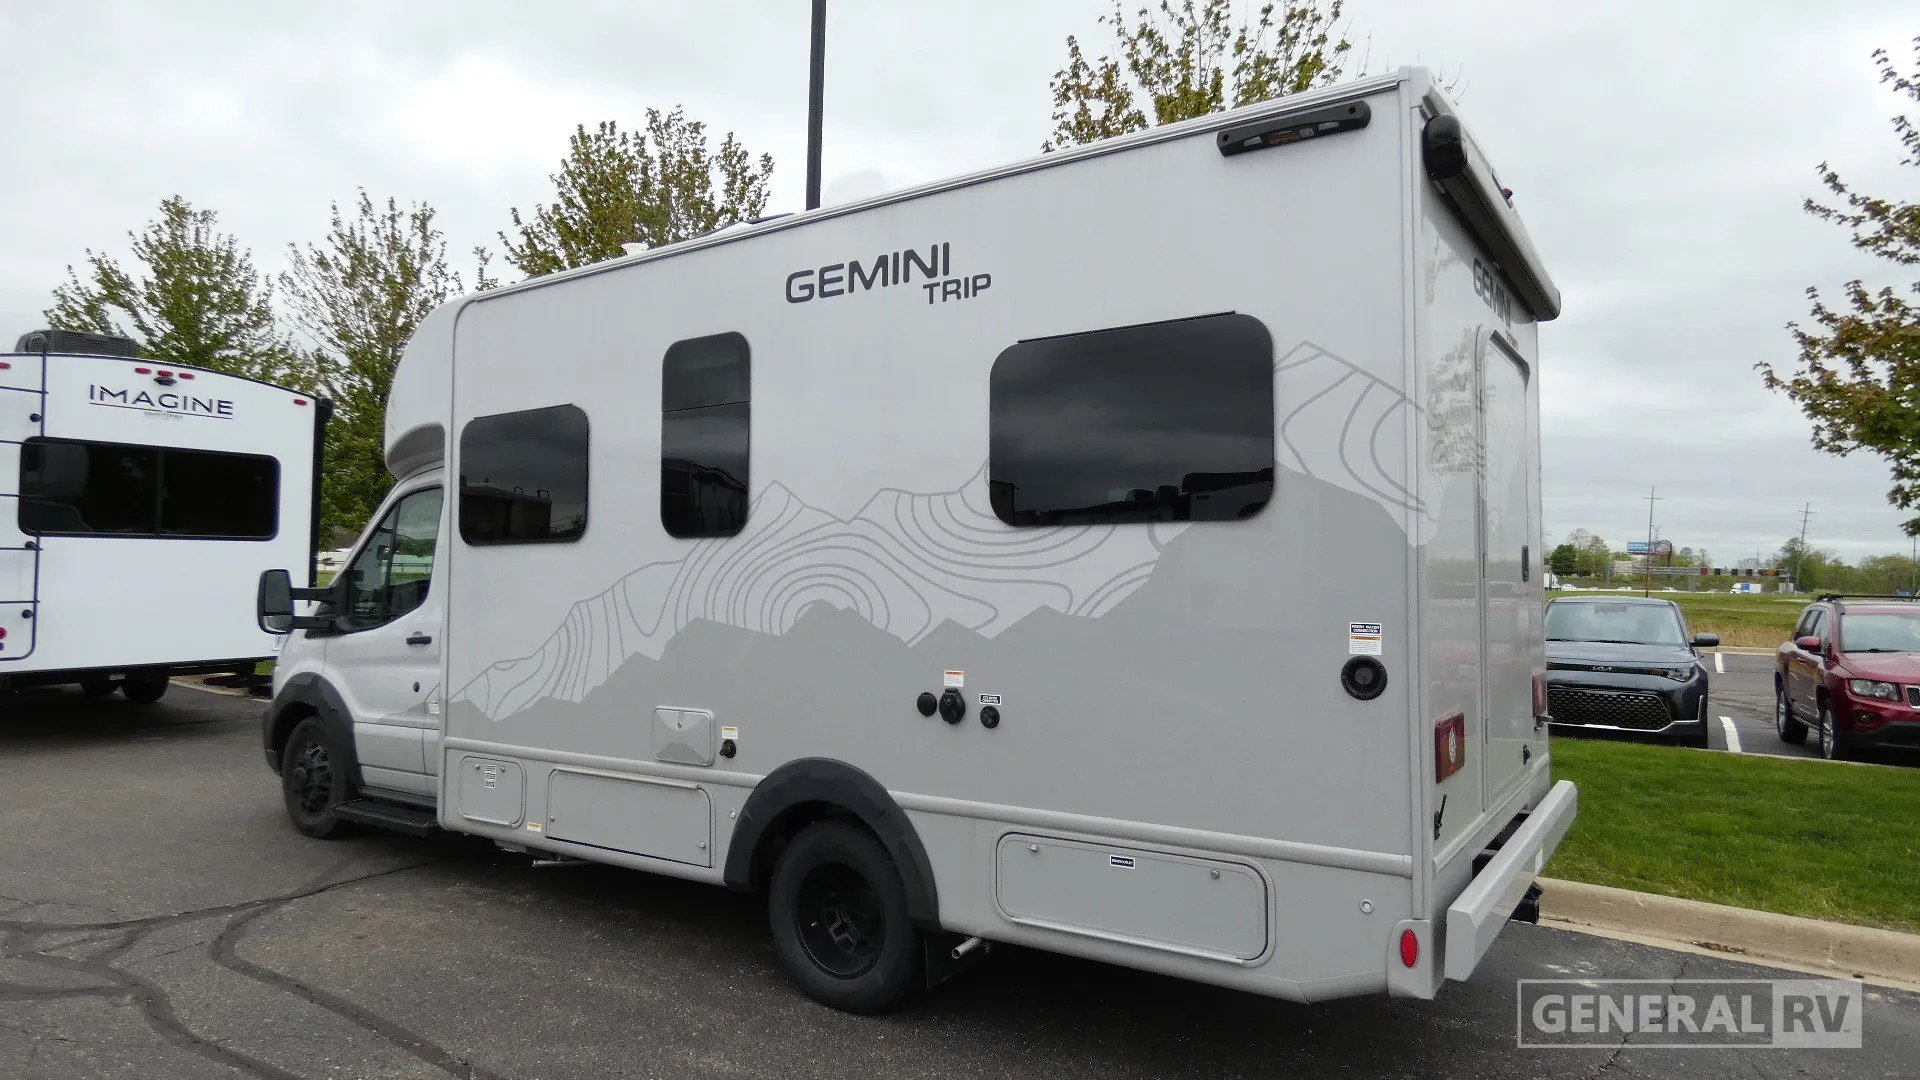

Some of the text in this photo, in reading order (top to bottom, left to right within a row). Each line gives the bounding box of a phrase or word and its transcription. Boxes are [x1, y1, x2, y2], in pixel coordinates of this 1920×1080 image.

[785, 242, 950, 304] GEMINI
[922, 273, 992, 305] TRIP
[1473, 257, 1511, 330] GEMINI
[89, 384, 234, 416] IMAGINE
